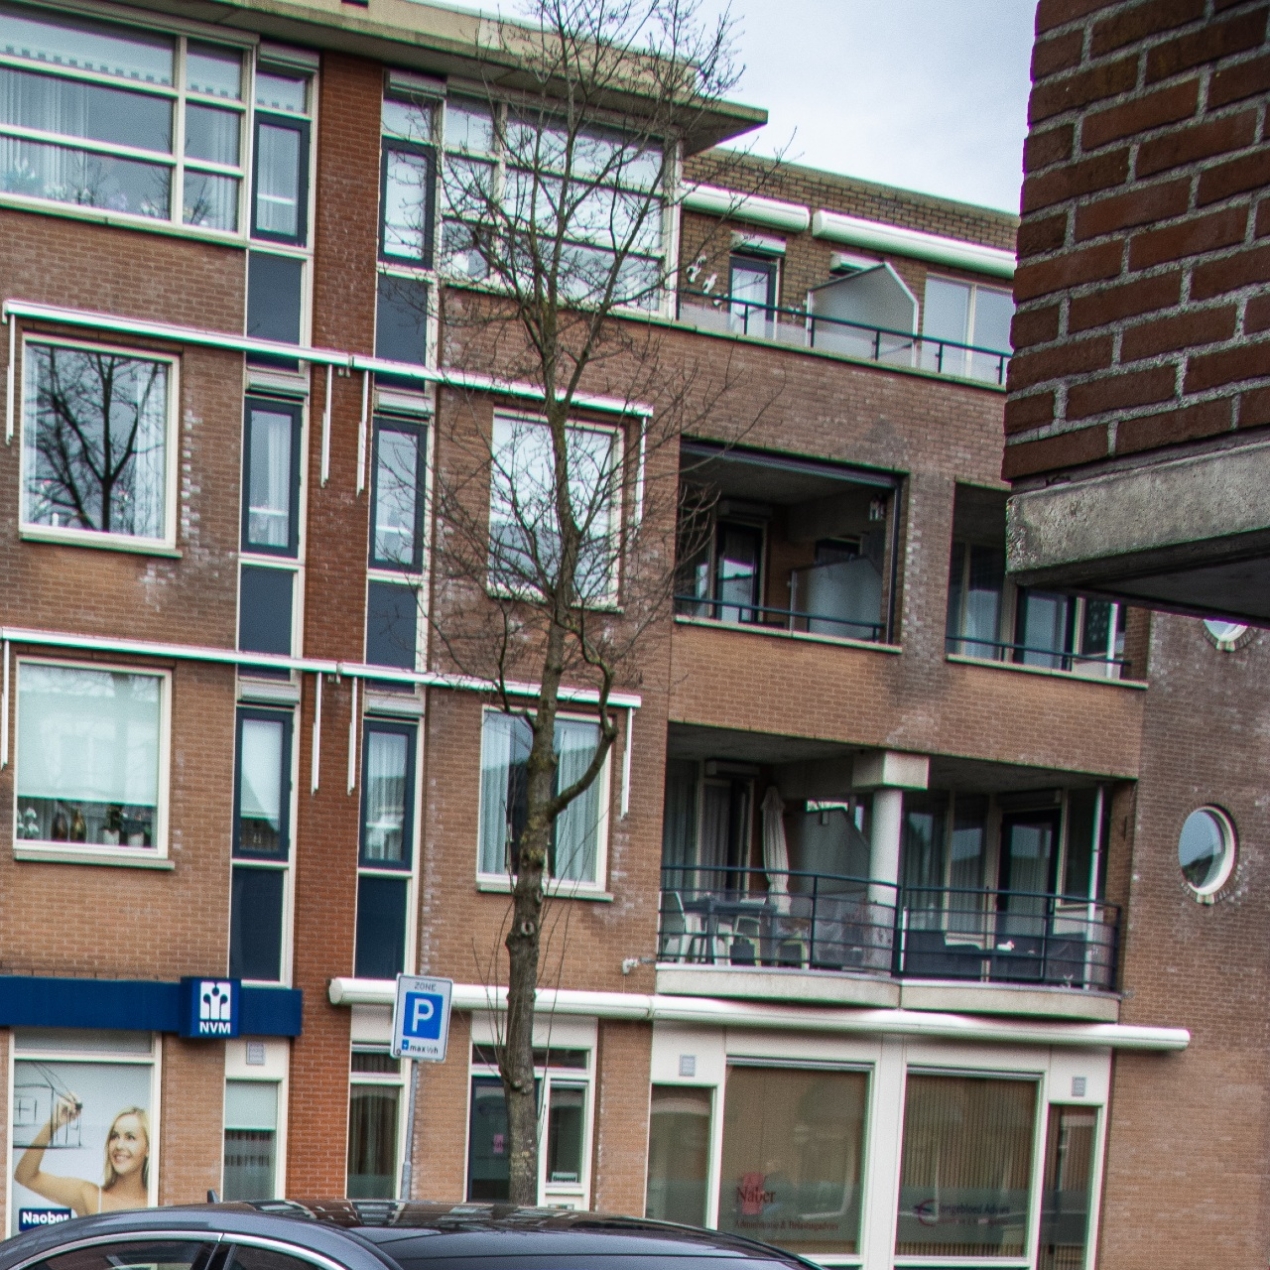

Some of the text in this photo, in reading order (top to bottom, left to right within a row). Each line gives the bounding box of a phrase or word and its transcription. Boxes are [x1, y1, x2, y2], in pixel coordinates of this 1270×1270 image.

[415, 982, 436, 991] ZONE
[412, 998, 435, 1033] P
[199, 1021, 231, 1034] NVM
[22, 1211, 70, 1225] Naober
